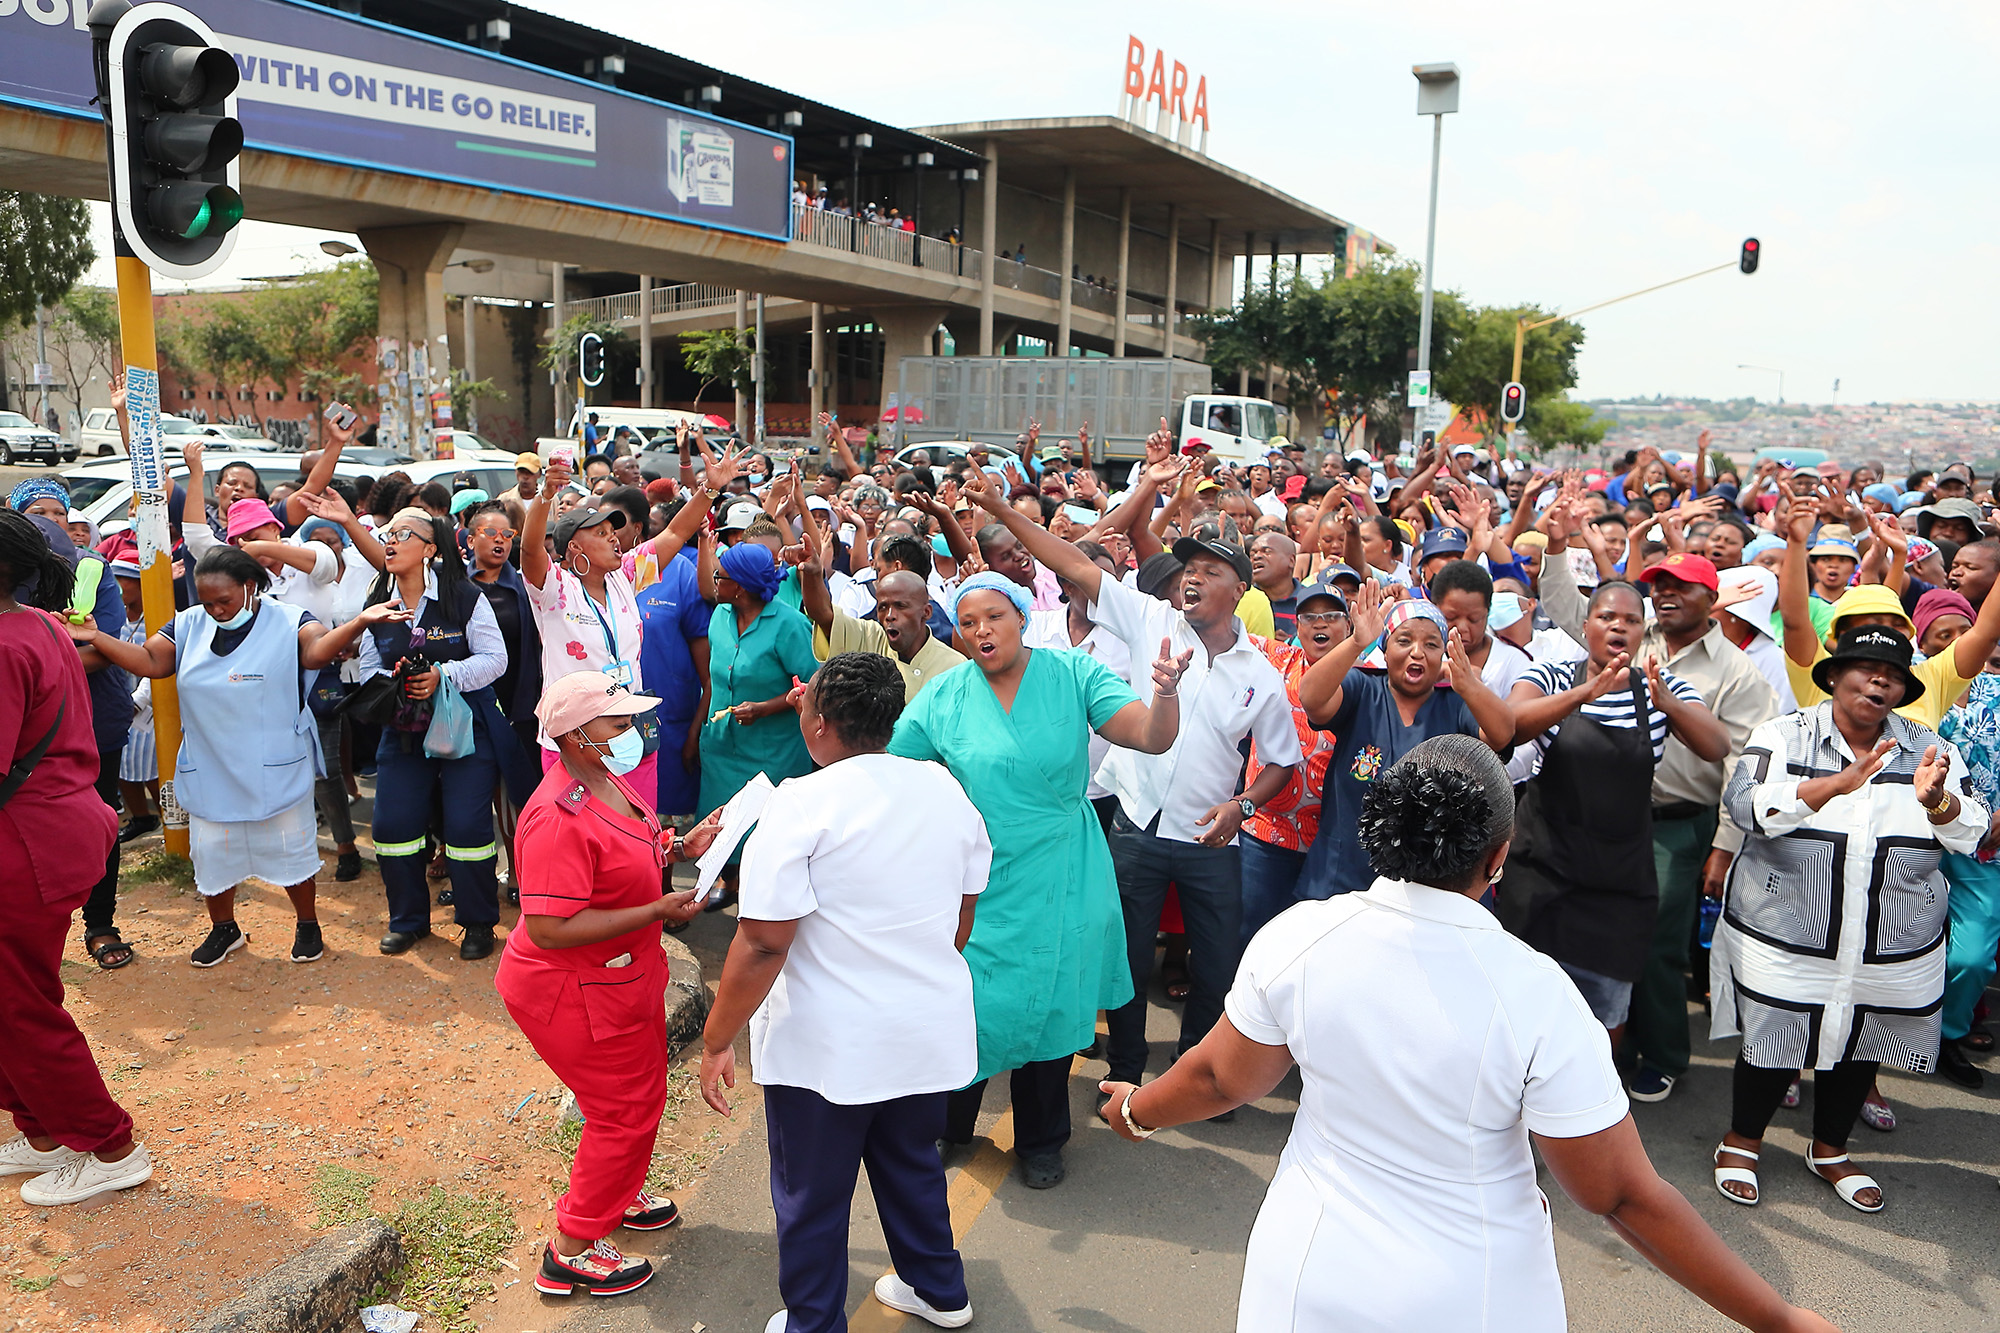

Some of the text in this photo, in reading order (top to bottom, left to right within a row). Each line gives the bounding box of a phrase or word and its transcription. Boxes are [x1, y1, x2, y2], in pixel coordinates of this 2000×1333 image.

[328, 71, 377, 102] ON
[384, 81, 444, 113] THE
[452, 93, 493, 120] GO
[501, 101, 591, 137] RELIEF.
[1125, 34, 1209, 131] BARA
[127, 369, 147, 392] 063
